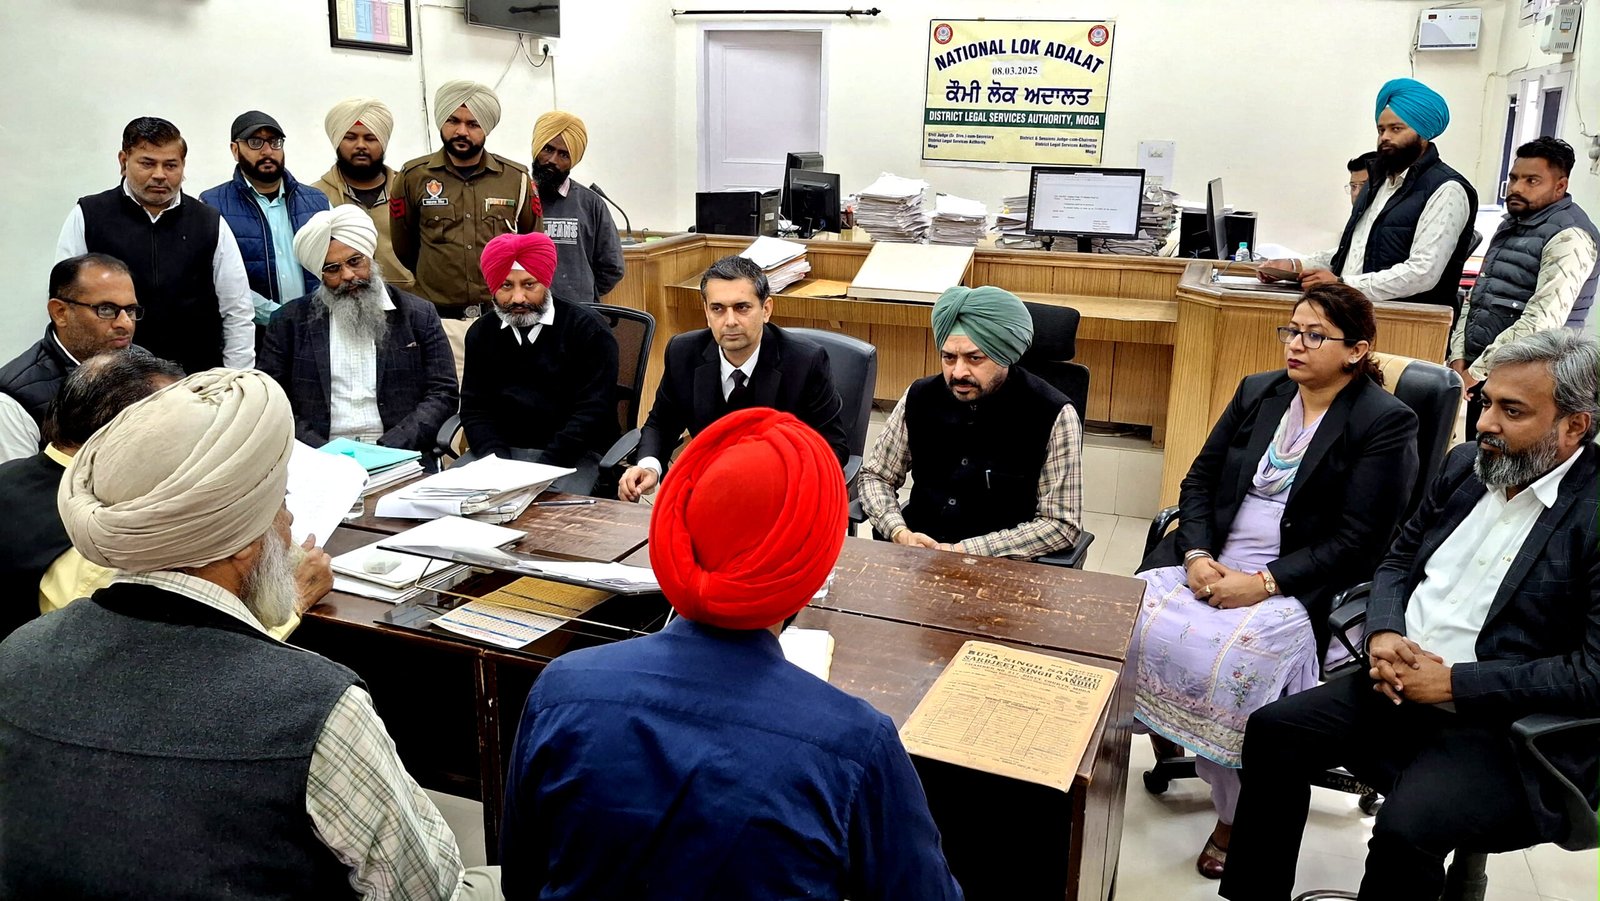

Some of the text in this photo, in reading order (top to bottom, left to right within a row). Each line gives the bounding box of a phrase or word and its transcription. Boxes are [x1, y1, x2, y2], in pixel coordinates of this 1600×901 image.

[934, 38, 1105, 74] NATIONAL LOK ADALAT
[992, 66, 1038, 75] 08.03.2025
[946, 79, 1093, 106] ਕੌਮੀ ਲੋਕ ਅਦਾਲਤ
[929, 111, 1100, 126] DISTRICT LEGAL SERVICES AUTHORITY, MOGA
[544, 223, 578, 238] JEANS
[962, 655, 1020, 670] SARBJEET
[1019, 667, 1052, 678] SINGH
[1055, 675, 1099, 690] SANDHU
[1003, 657, 1043, 670] SINGH
[1047, 668, 1101, 683] SANDHU
